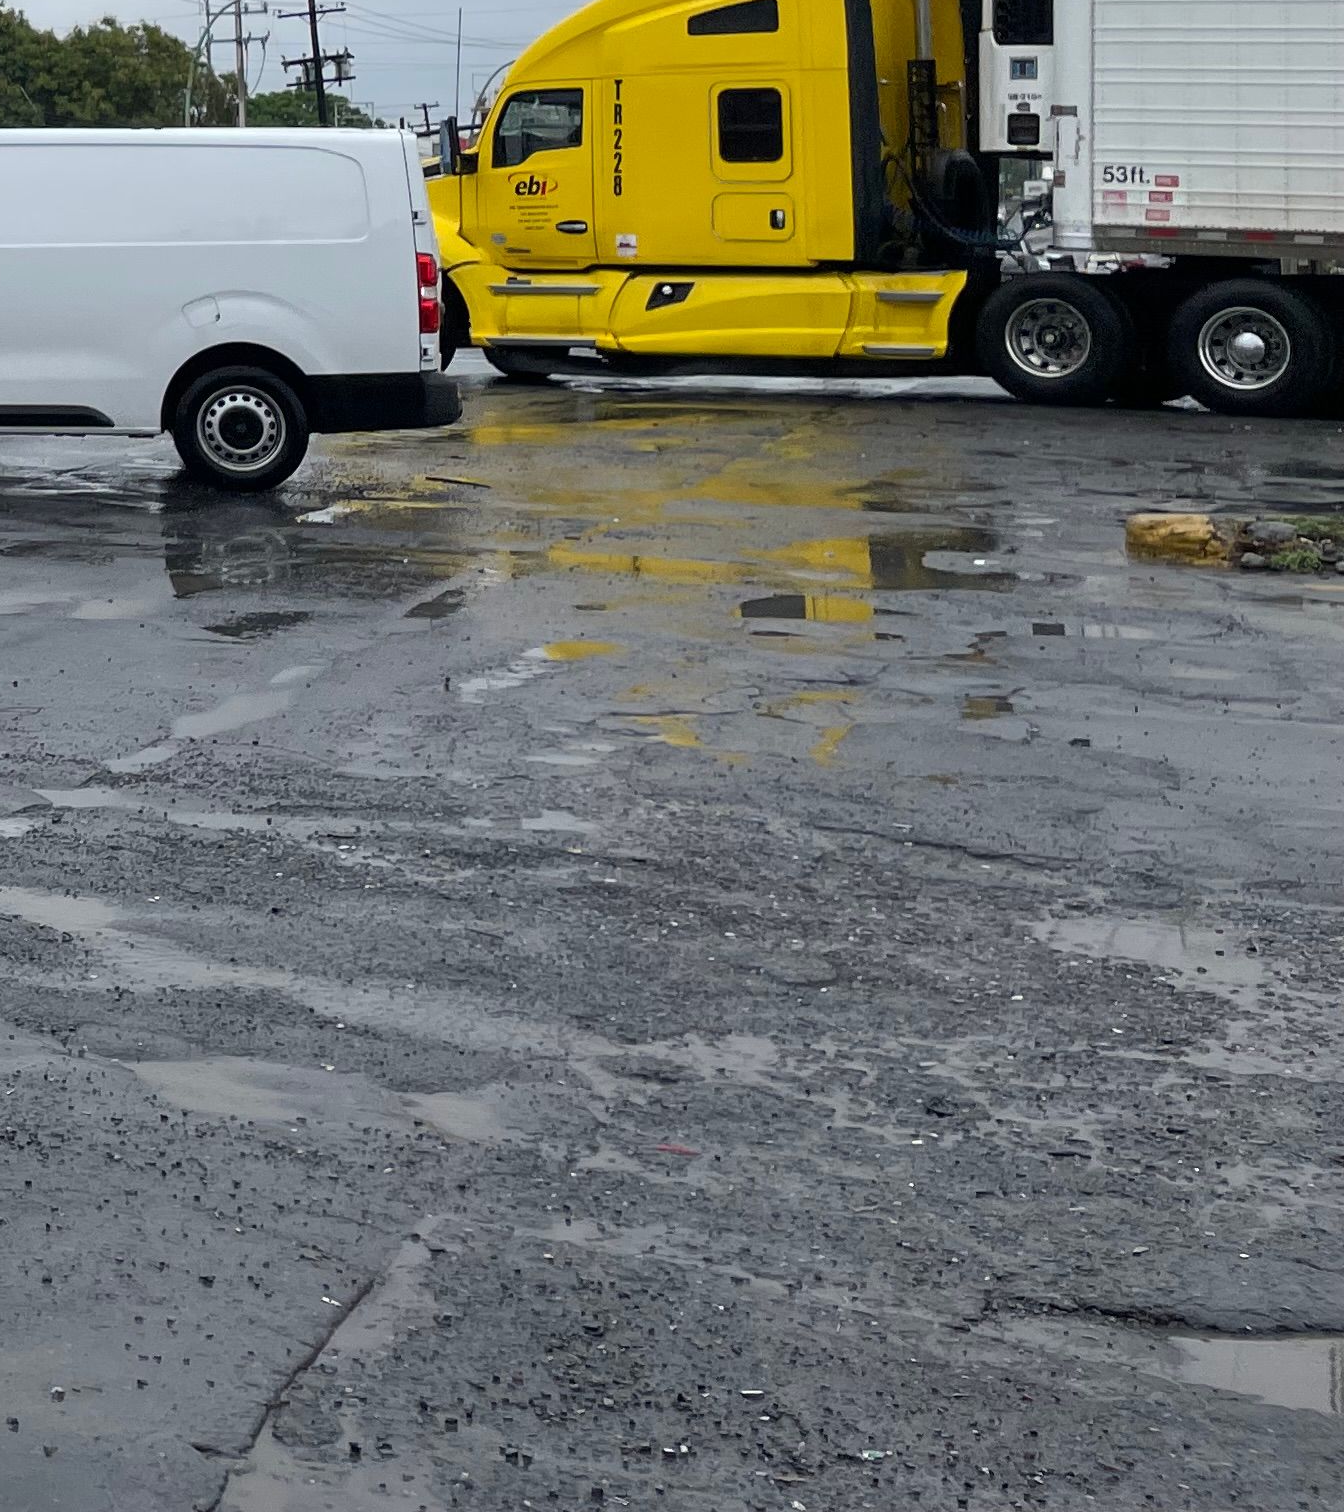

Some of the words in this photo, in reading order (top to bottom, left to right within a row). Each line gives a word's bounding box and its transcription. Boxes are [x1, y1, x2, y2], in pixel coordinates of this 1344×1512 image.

[613, 78, 623, 197] TR228
[514, 174, 548, 196] ebi
[1102, 165, 1151, 184] 53ft.
